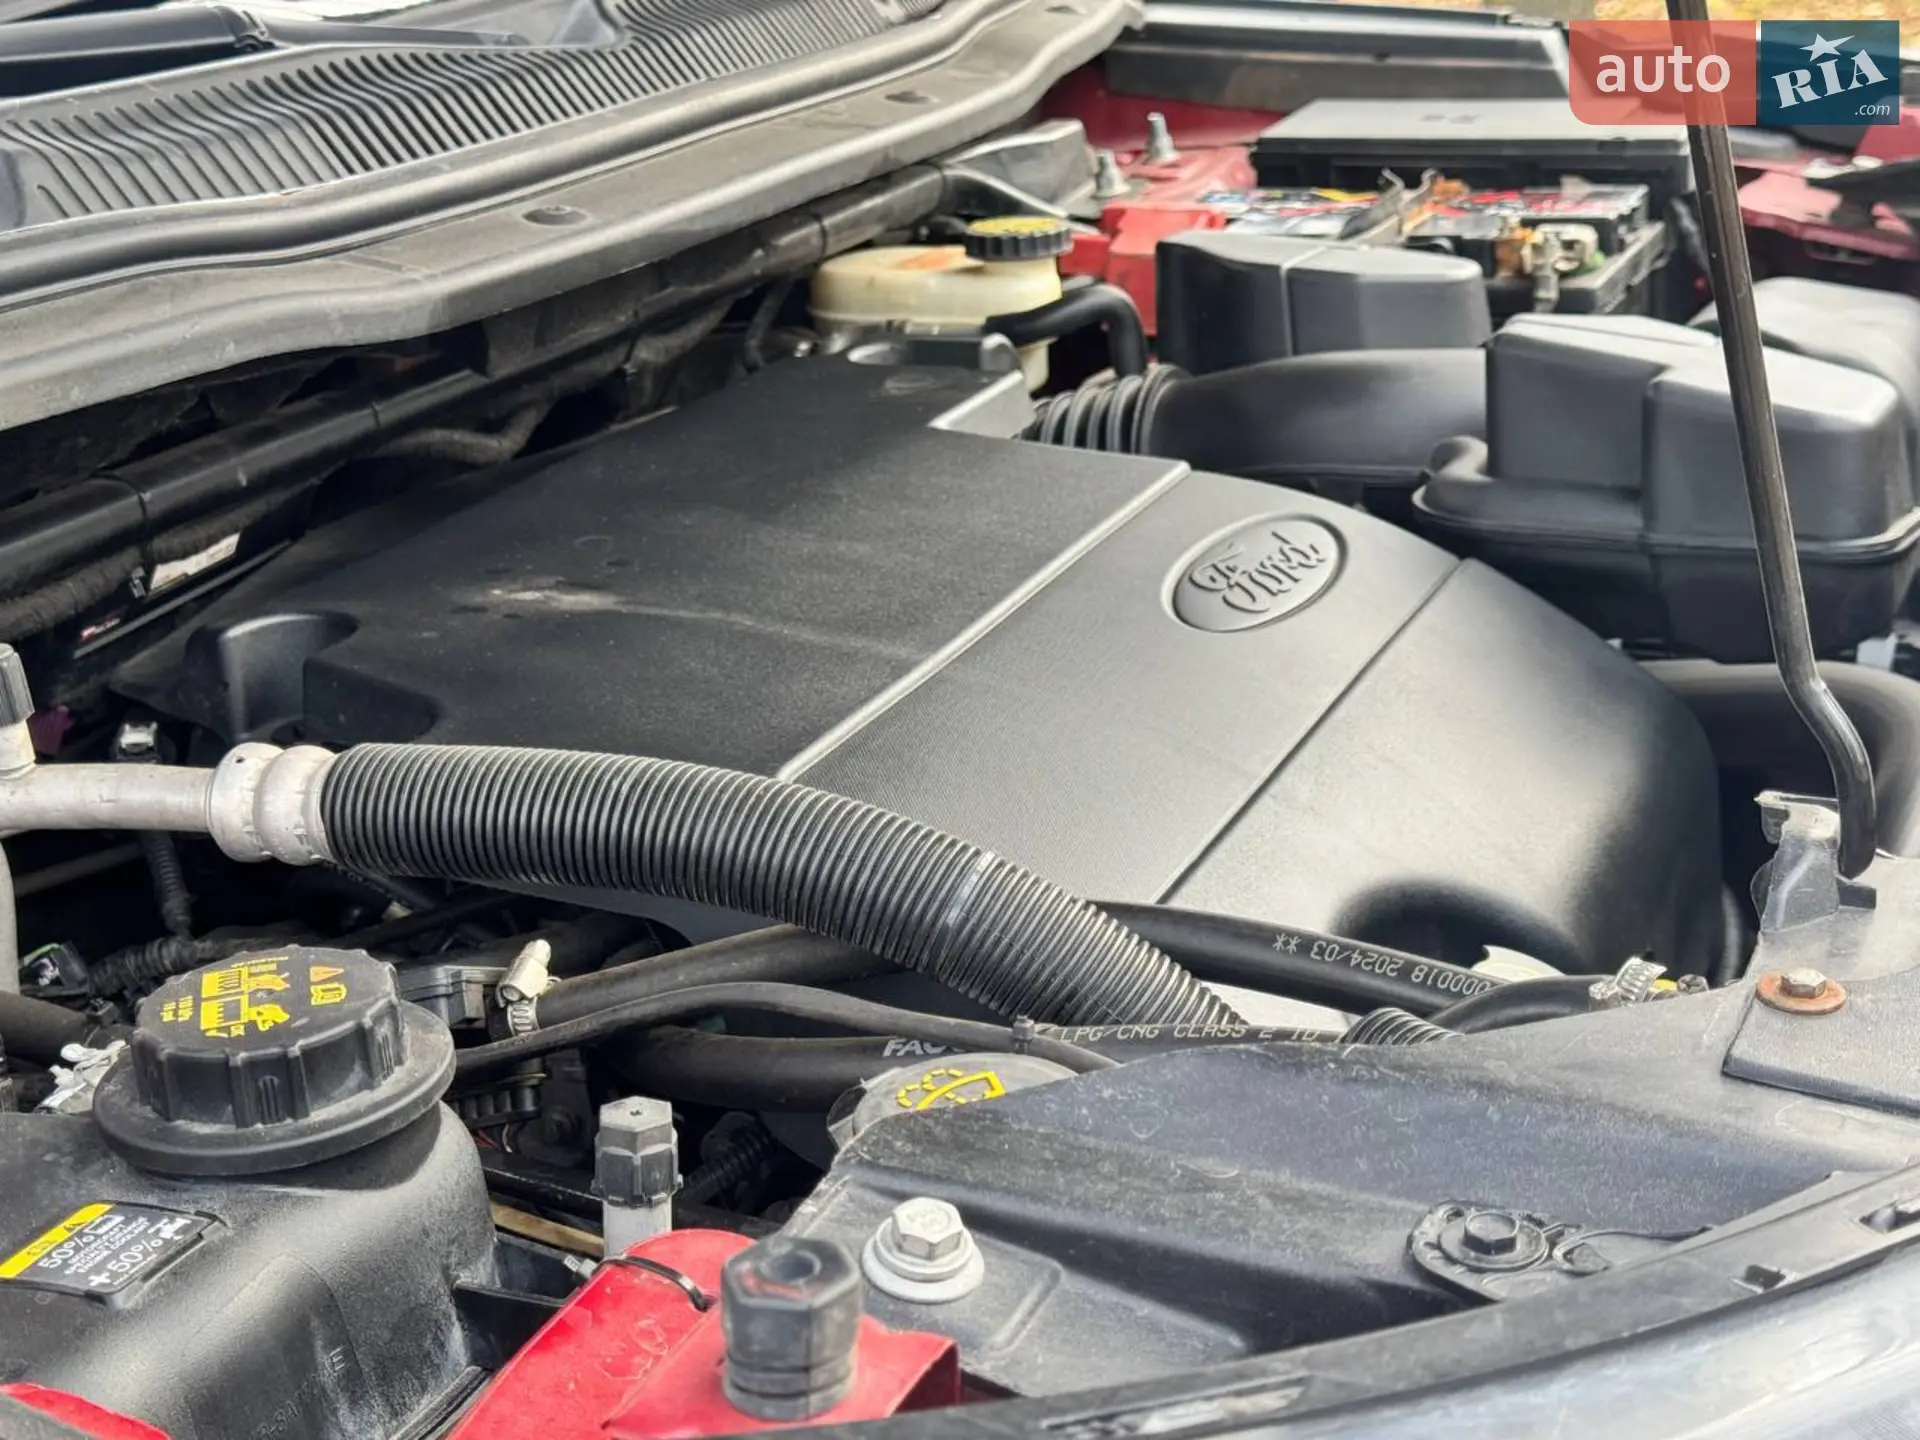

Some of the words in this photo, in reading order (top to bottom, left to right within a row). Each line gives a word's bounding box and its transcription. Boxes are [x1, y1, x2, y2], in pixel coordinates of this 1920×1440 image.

[1188, 531, 1326, 614] Ford
[1310, 940, 1404, 977] 2024/03
[1059, 1024, 1160, 1043] LPG/CNG
[1173, 1023, 1249, 1039] CLASS
[37, 1233, 95, 1269] 50%
[106, 1239, 163, 1273] 50%
